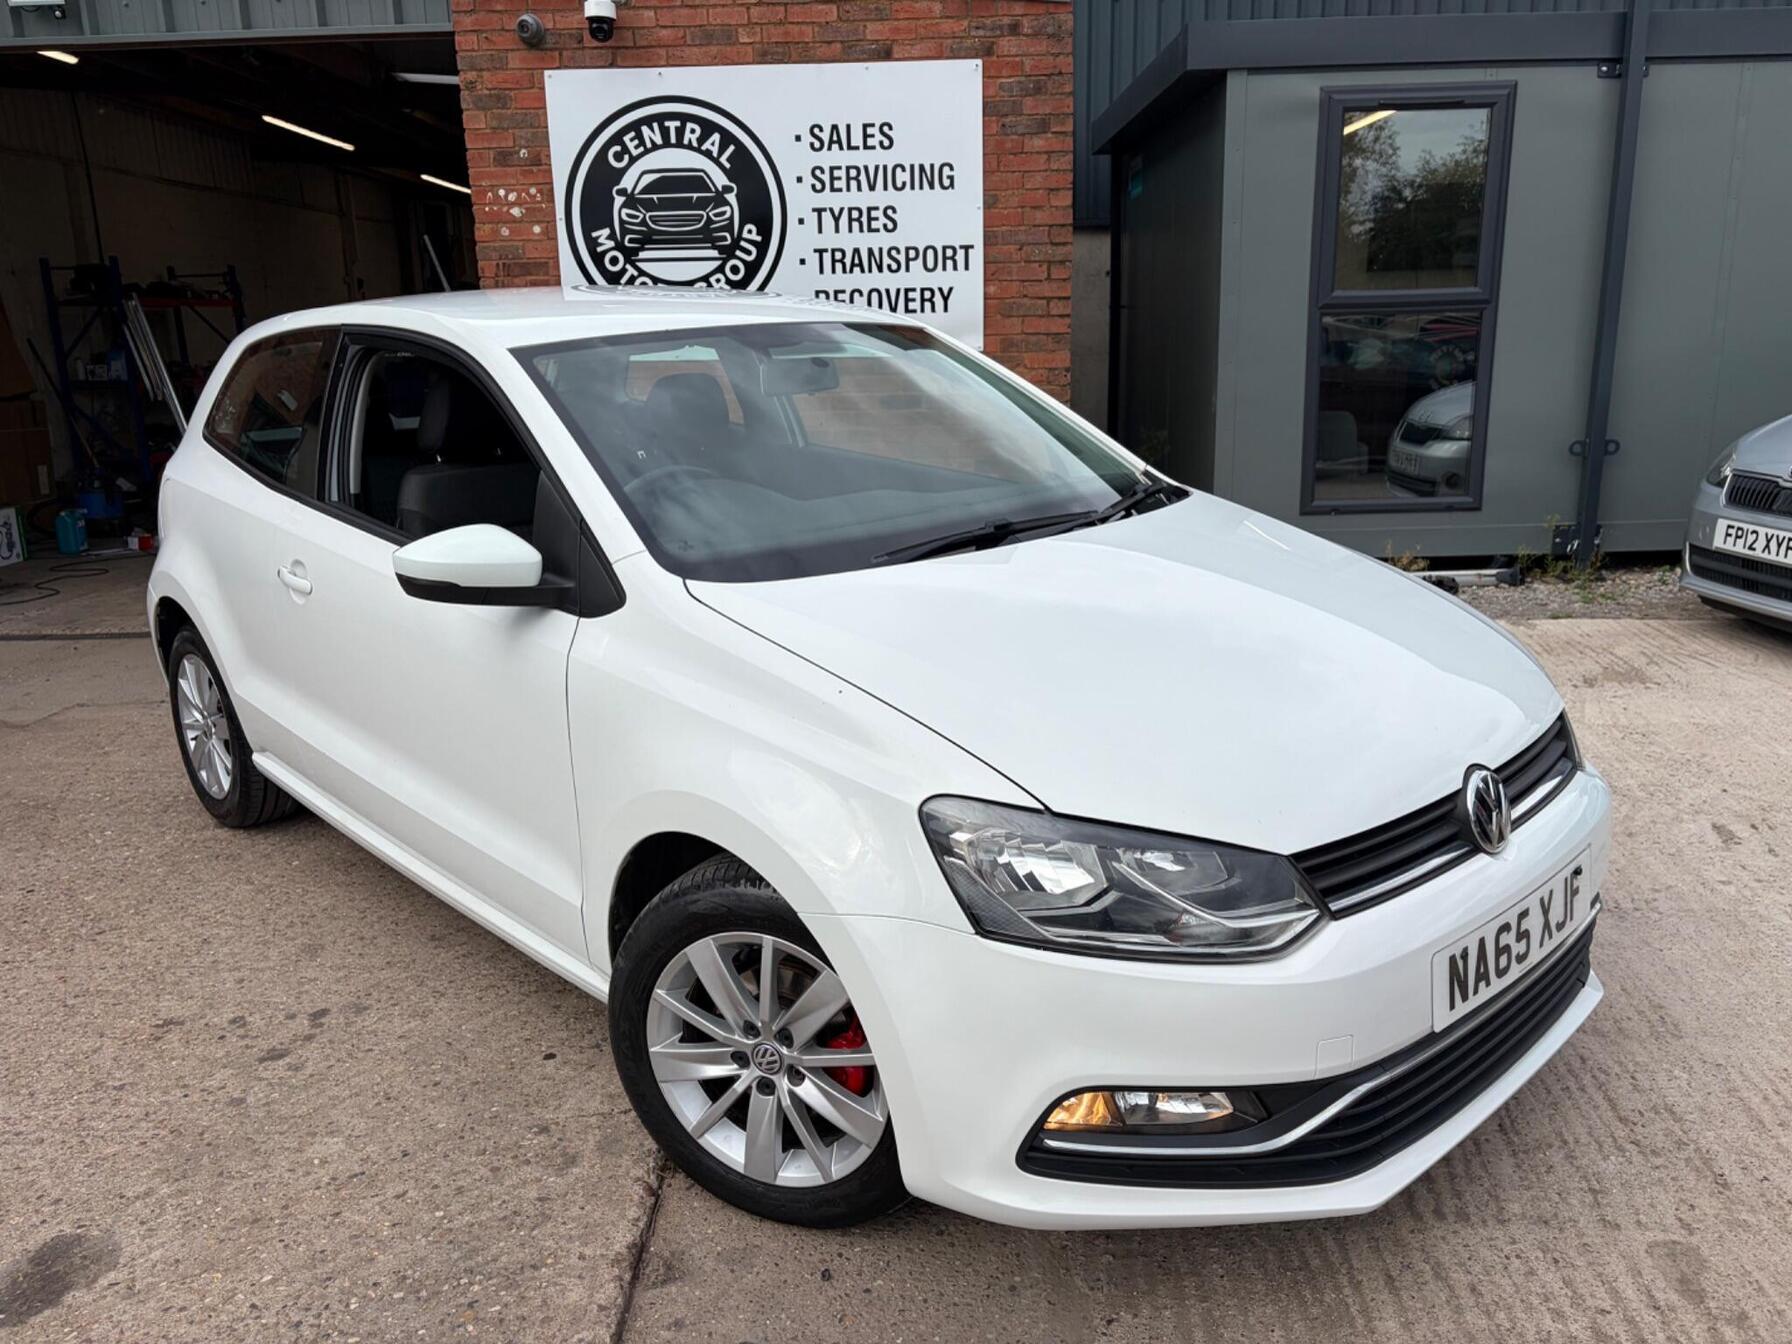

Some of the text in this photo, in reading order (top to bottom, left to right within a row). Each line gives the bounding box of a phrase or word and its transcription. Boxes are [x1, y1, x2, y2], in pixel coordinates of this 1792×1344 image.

[607, 119, 736, 171] CENTRAL
[808, 121, 895, 153] SALES
[810, 162, 956, 194] SERVICING
[811, 205, 898, 234] TYRES
[591, 227, 669, 287] MOT
[813, 244, 975, 275] TRANSPORT
[1723, 524, 1759, 552] FP12
[1448, 864, 1583, 1012] NA65 XJF
